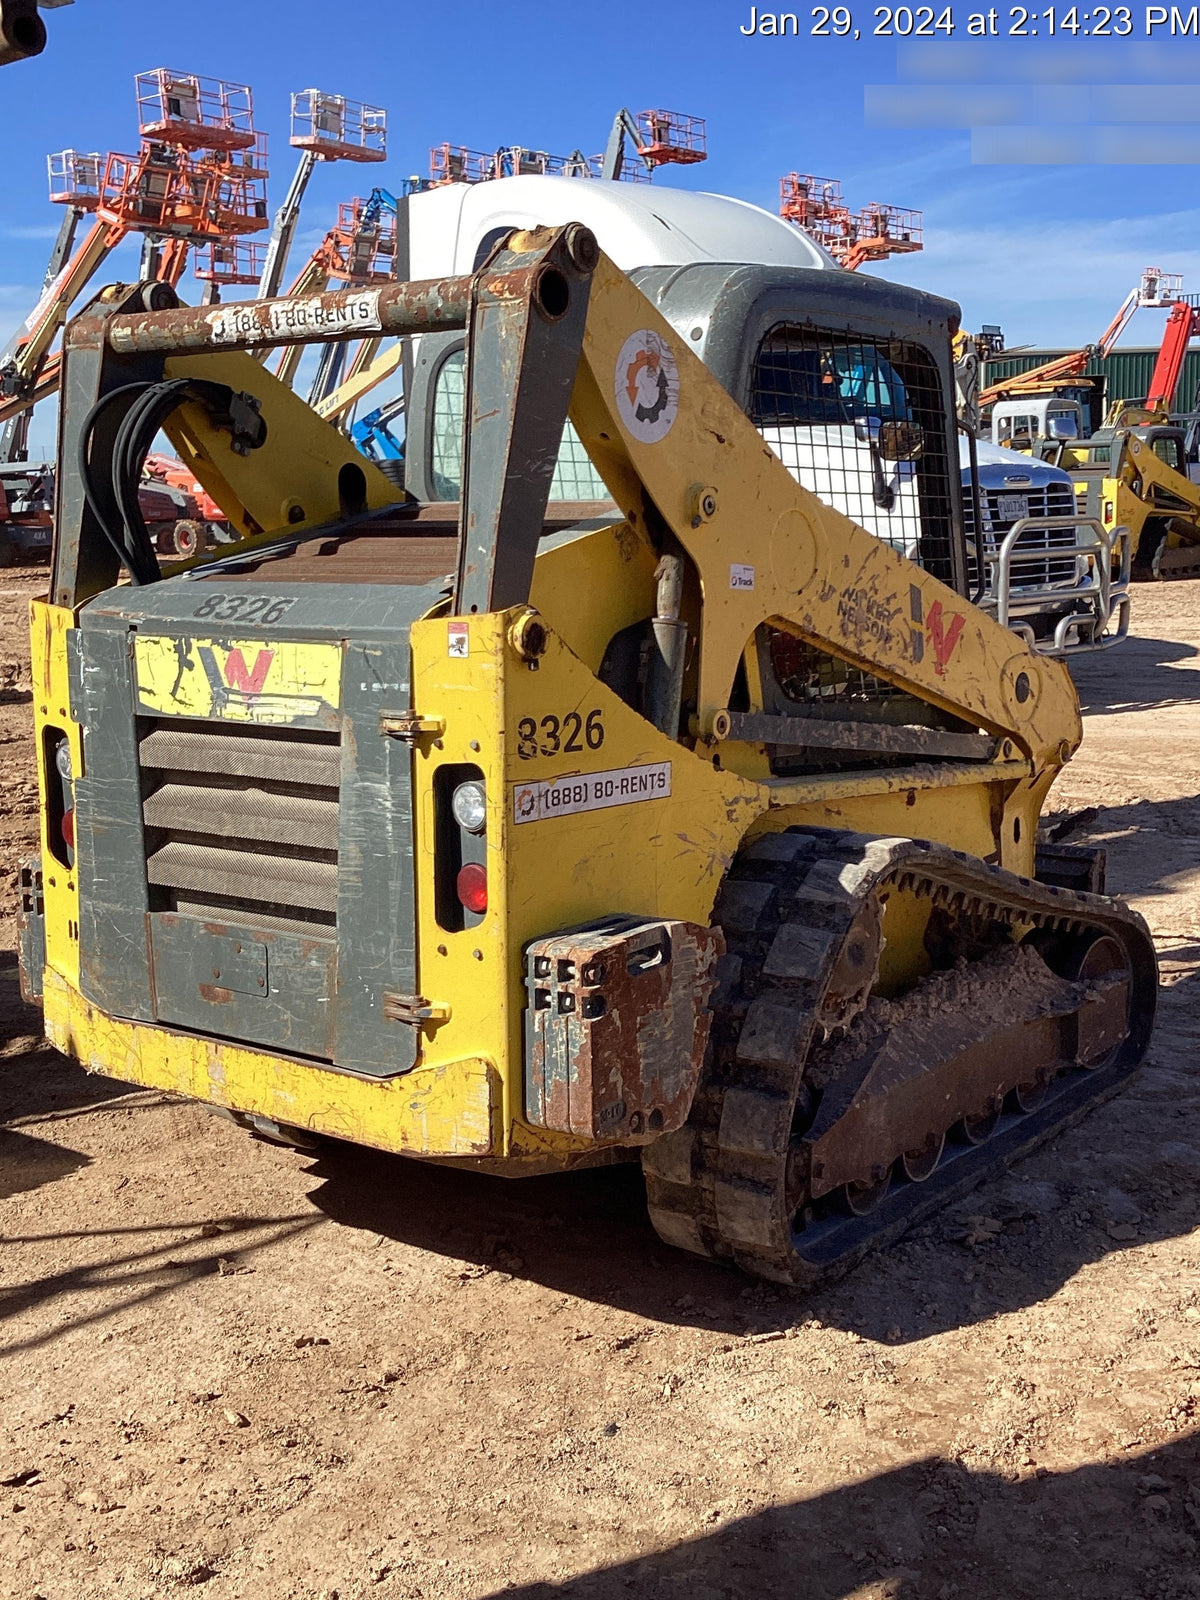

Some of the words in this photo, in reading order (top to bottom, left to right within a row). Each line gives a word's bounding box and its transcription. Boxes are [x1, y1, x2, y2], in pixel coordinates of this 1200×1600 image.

[192, 594, 294, 624] 8326
[517, 709, 605, 761] 8326
[544, 782, 588, 810] (888)
[594, 771, 667, 800] 80-RENTS
